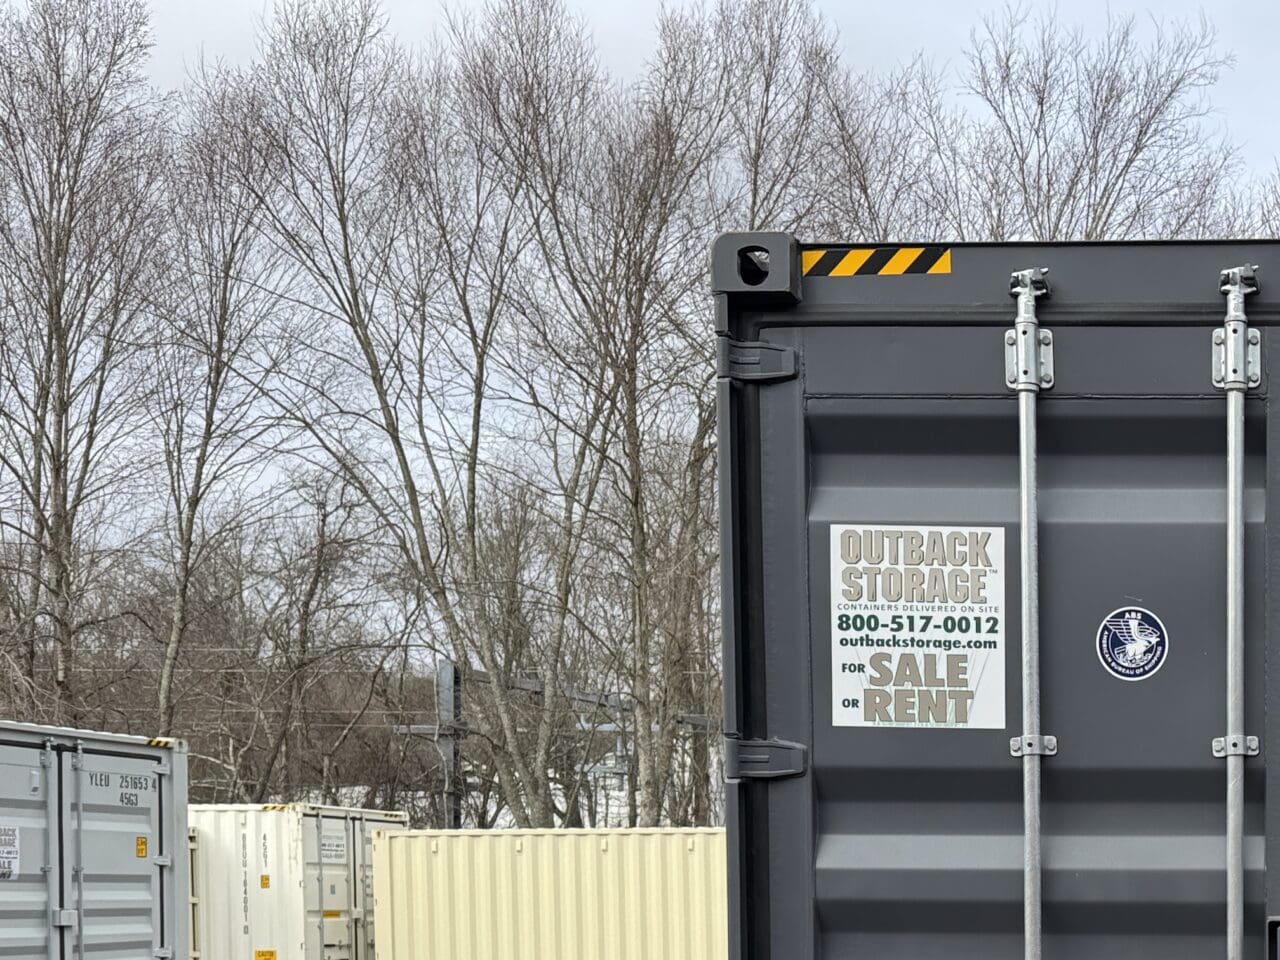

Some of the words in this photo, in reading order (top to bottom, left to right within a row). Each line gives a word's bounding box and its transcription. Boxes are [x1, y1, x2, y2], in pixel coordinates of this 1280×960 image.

[841, 529, 993, 567] OUTBACK
[841, 566, 987, 604] STORAGE
[837, 603, 899, 611] CONTAINERS
[902, 604, 956, 613] DELIVERED
[960, 605, 975, 613] ON
[837, 614, 999, 634] 800-517-0012
[839, 634, 998, 650] outbackstorage.com
[842, 663, 865, 673] FOR
[869, 652, 968, 687] SALE
[842, 699, 859, 708] OR
[864, 689, 975, 723] RENT
[89, 772, 110, 787] YLEU
